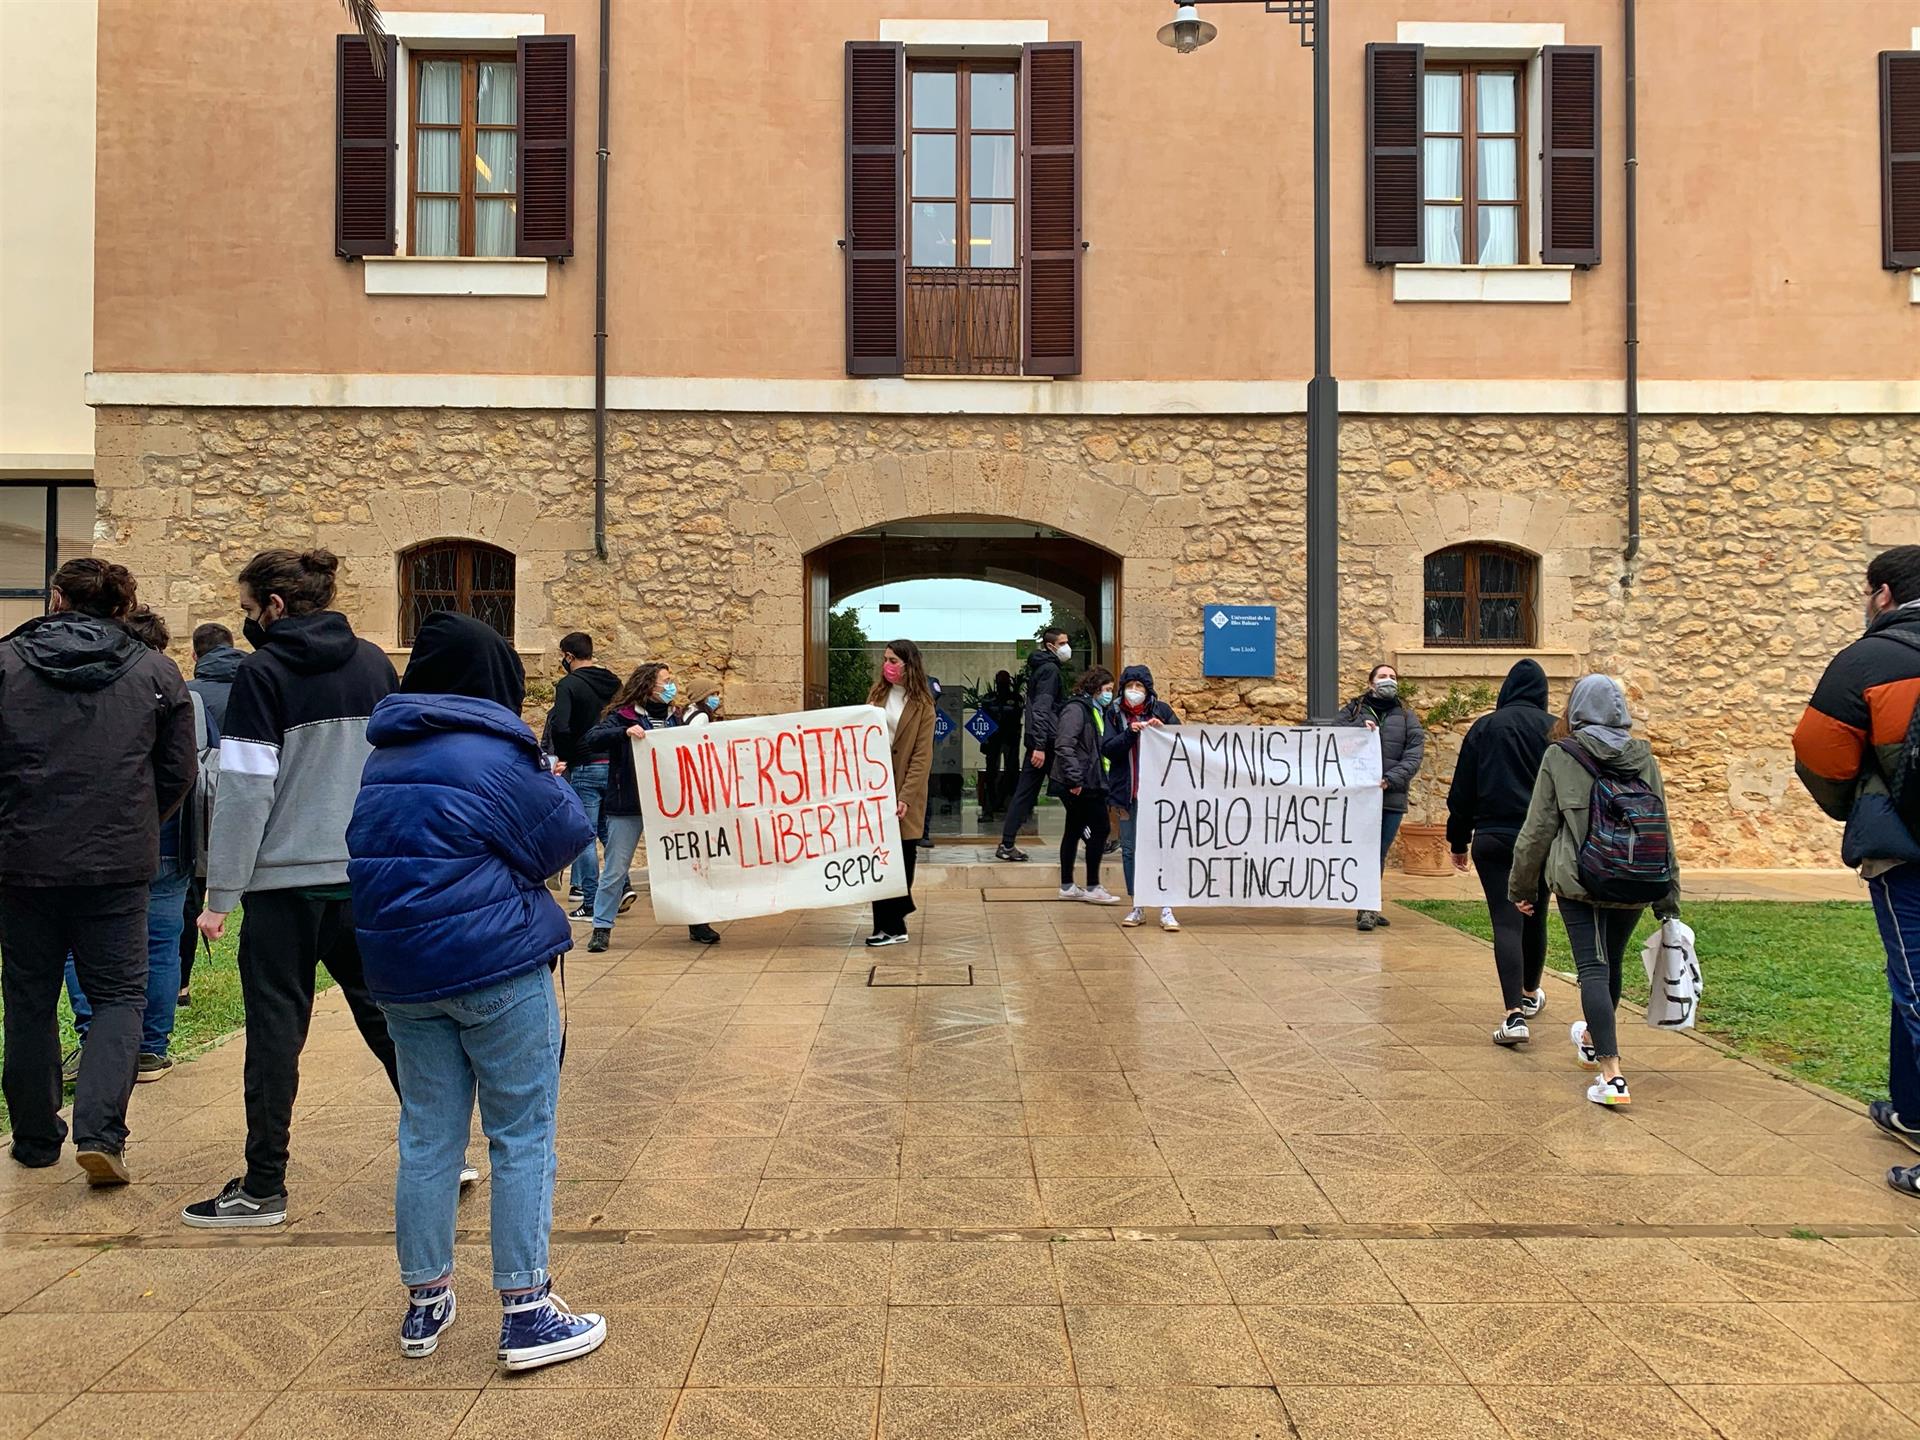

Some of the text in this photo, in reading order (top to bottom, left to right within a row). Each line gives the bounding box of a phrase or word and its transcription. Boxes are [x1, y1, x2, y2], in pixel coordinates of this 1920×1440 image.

[972, 722, 990, 731] UIB
[1154, 788, 1353, 850] PABLO HASÉL
[659, 832, 700, 861] PER
[705, 826, 731, 858] LA
[1157, 868, 1167, 891] i
